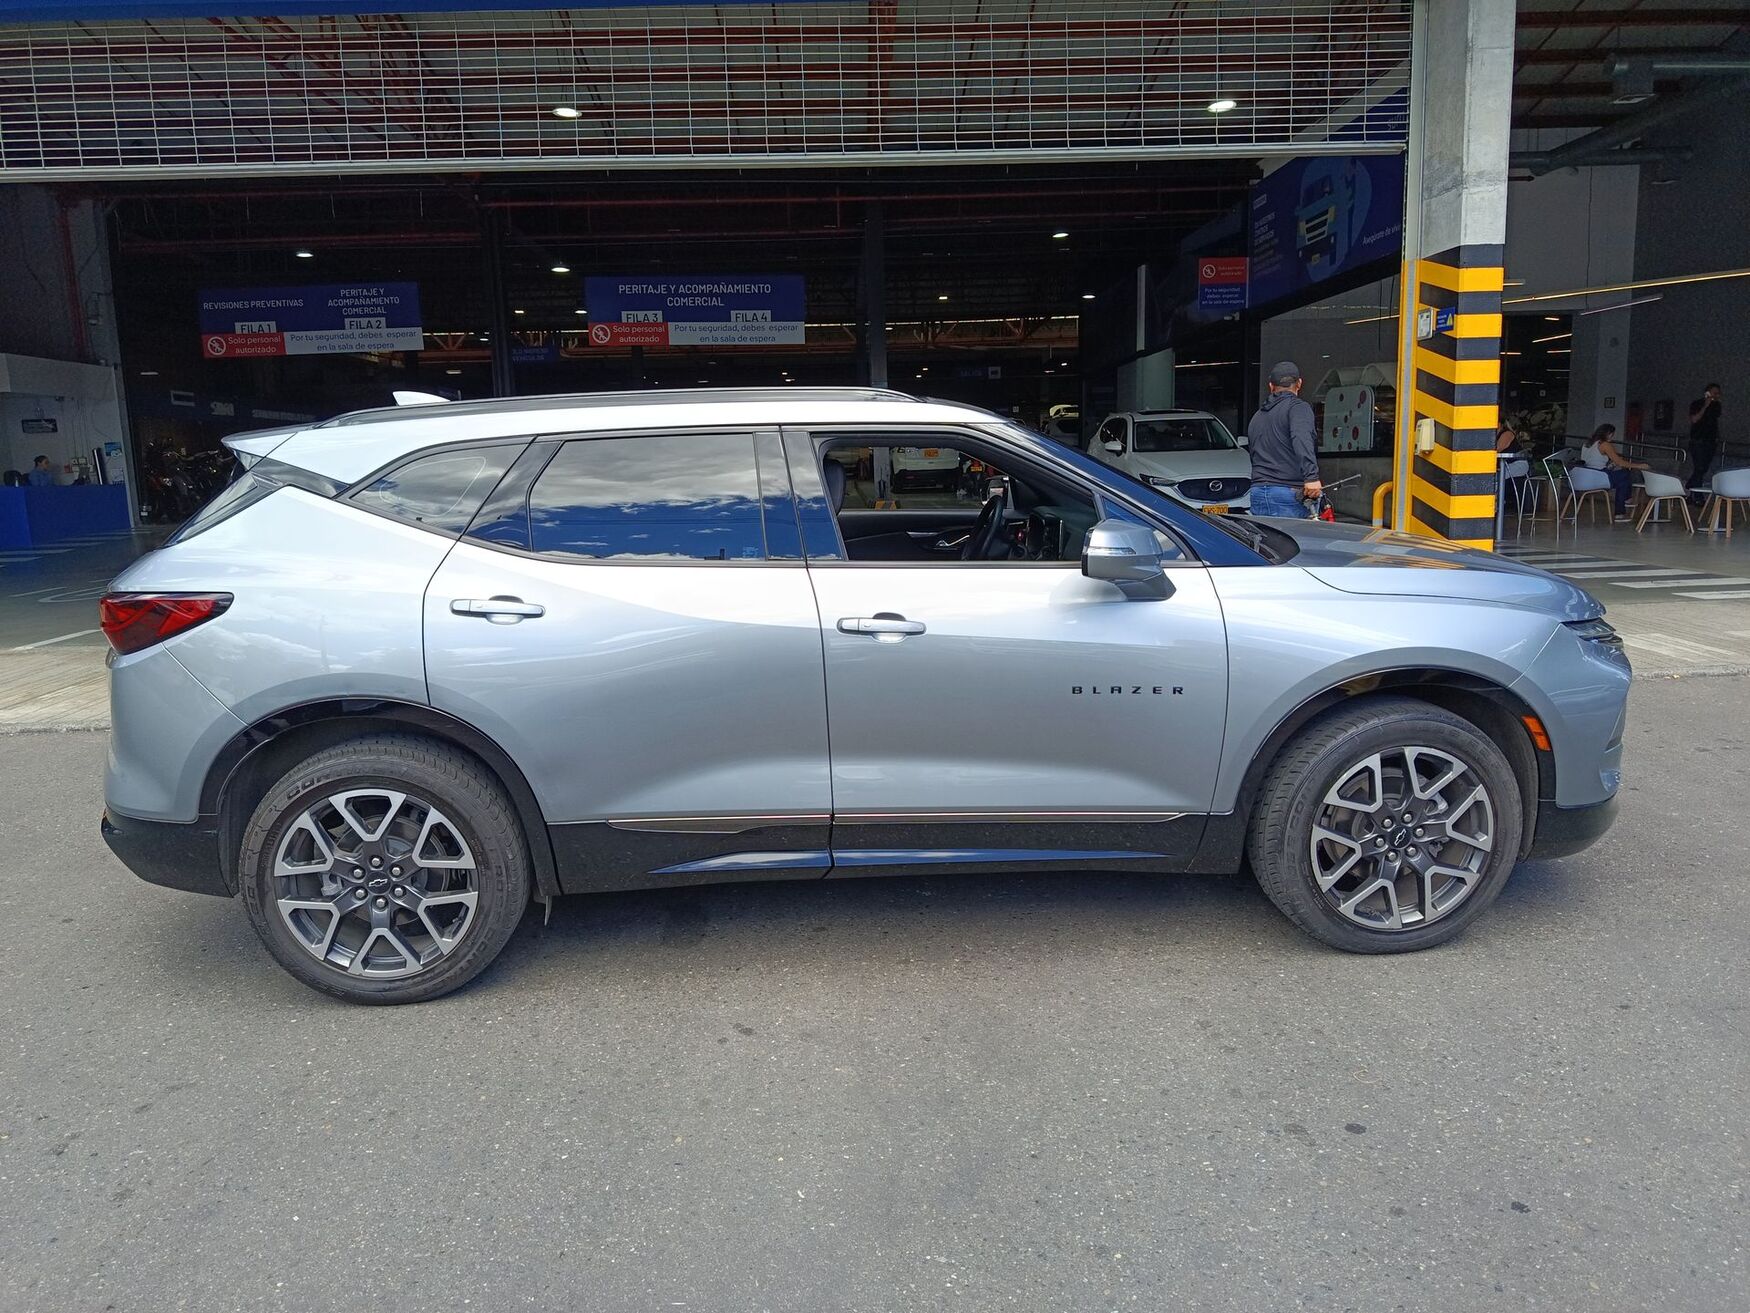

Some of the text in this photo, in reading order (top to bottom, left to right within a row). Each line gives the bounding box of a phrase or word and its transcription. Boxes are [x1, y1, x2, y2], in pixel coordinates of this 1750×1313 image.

[340, 288, 385, 297] PERITAJE Y
[618, 282, 771, 294] PERITAJE Y ACOMPAÑAMIENTO
[203, 299, 304, 310] REVISIONES PREVENTIVAS
[327, 296, 400, 307] ACOMPAÑAMIENTO
[667, 297, 725, 307] COMERCIAL
[342, 306, 387, 315] COMERCIAL
[626, 313, 659, 323] FILA 3
[735, 312, 768, 322] FILA 4
[240, 323, 265, 333] FILA
[349, 320, 382, 330] FILA 2
[613, 325, 665, 335] Solo personal
[674, 324, 687, 332] Por
[698, 324, 740, 334] seguridad,
[741, 324, 765, 332] debes
[768, 325, 798, 334] esperar
[228, 336, 281, 346] Solo personal
[290, 334, 302, 342] Por
[358, 331, 383, 339] debes
[386, 331, 416, 341] esperar
[619, 335, 660, 343] autorizado
[711, 335, 719, 343] la
[720, 335, 736, 343] sala
[737, 335, 747, 343] de
[749, 336, 776, 344] espera
[235, 345, 277, 354] autorizado
[328, 343, 336, 351] la
[338, 343, 354, 351] sala
[355, 342, 366, 350] de
[367, 342, 395, 352] espera
[1071, 685, 1184, 695] BLAZER
